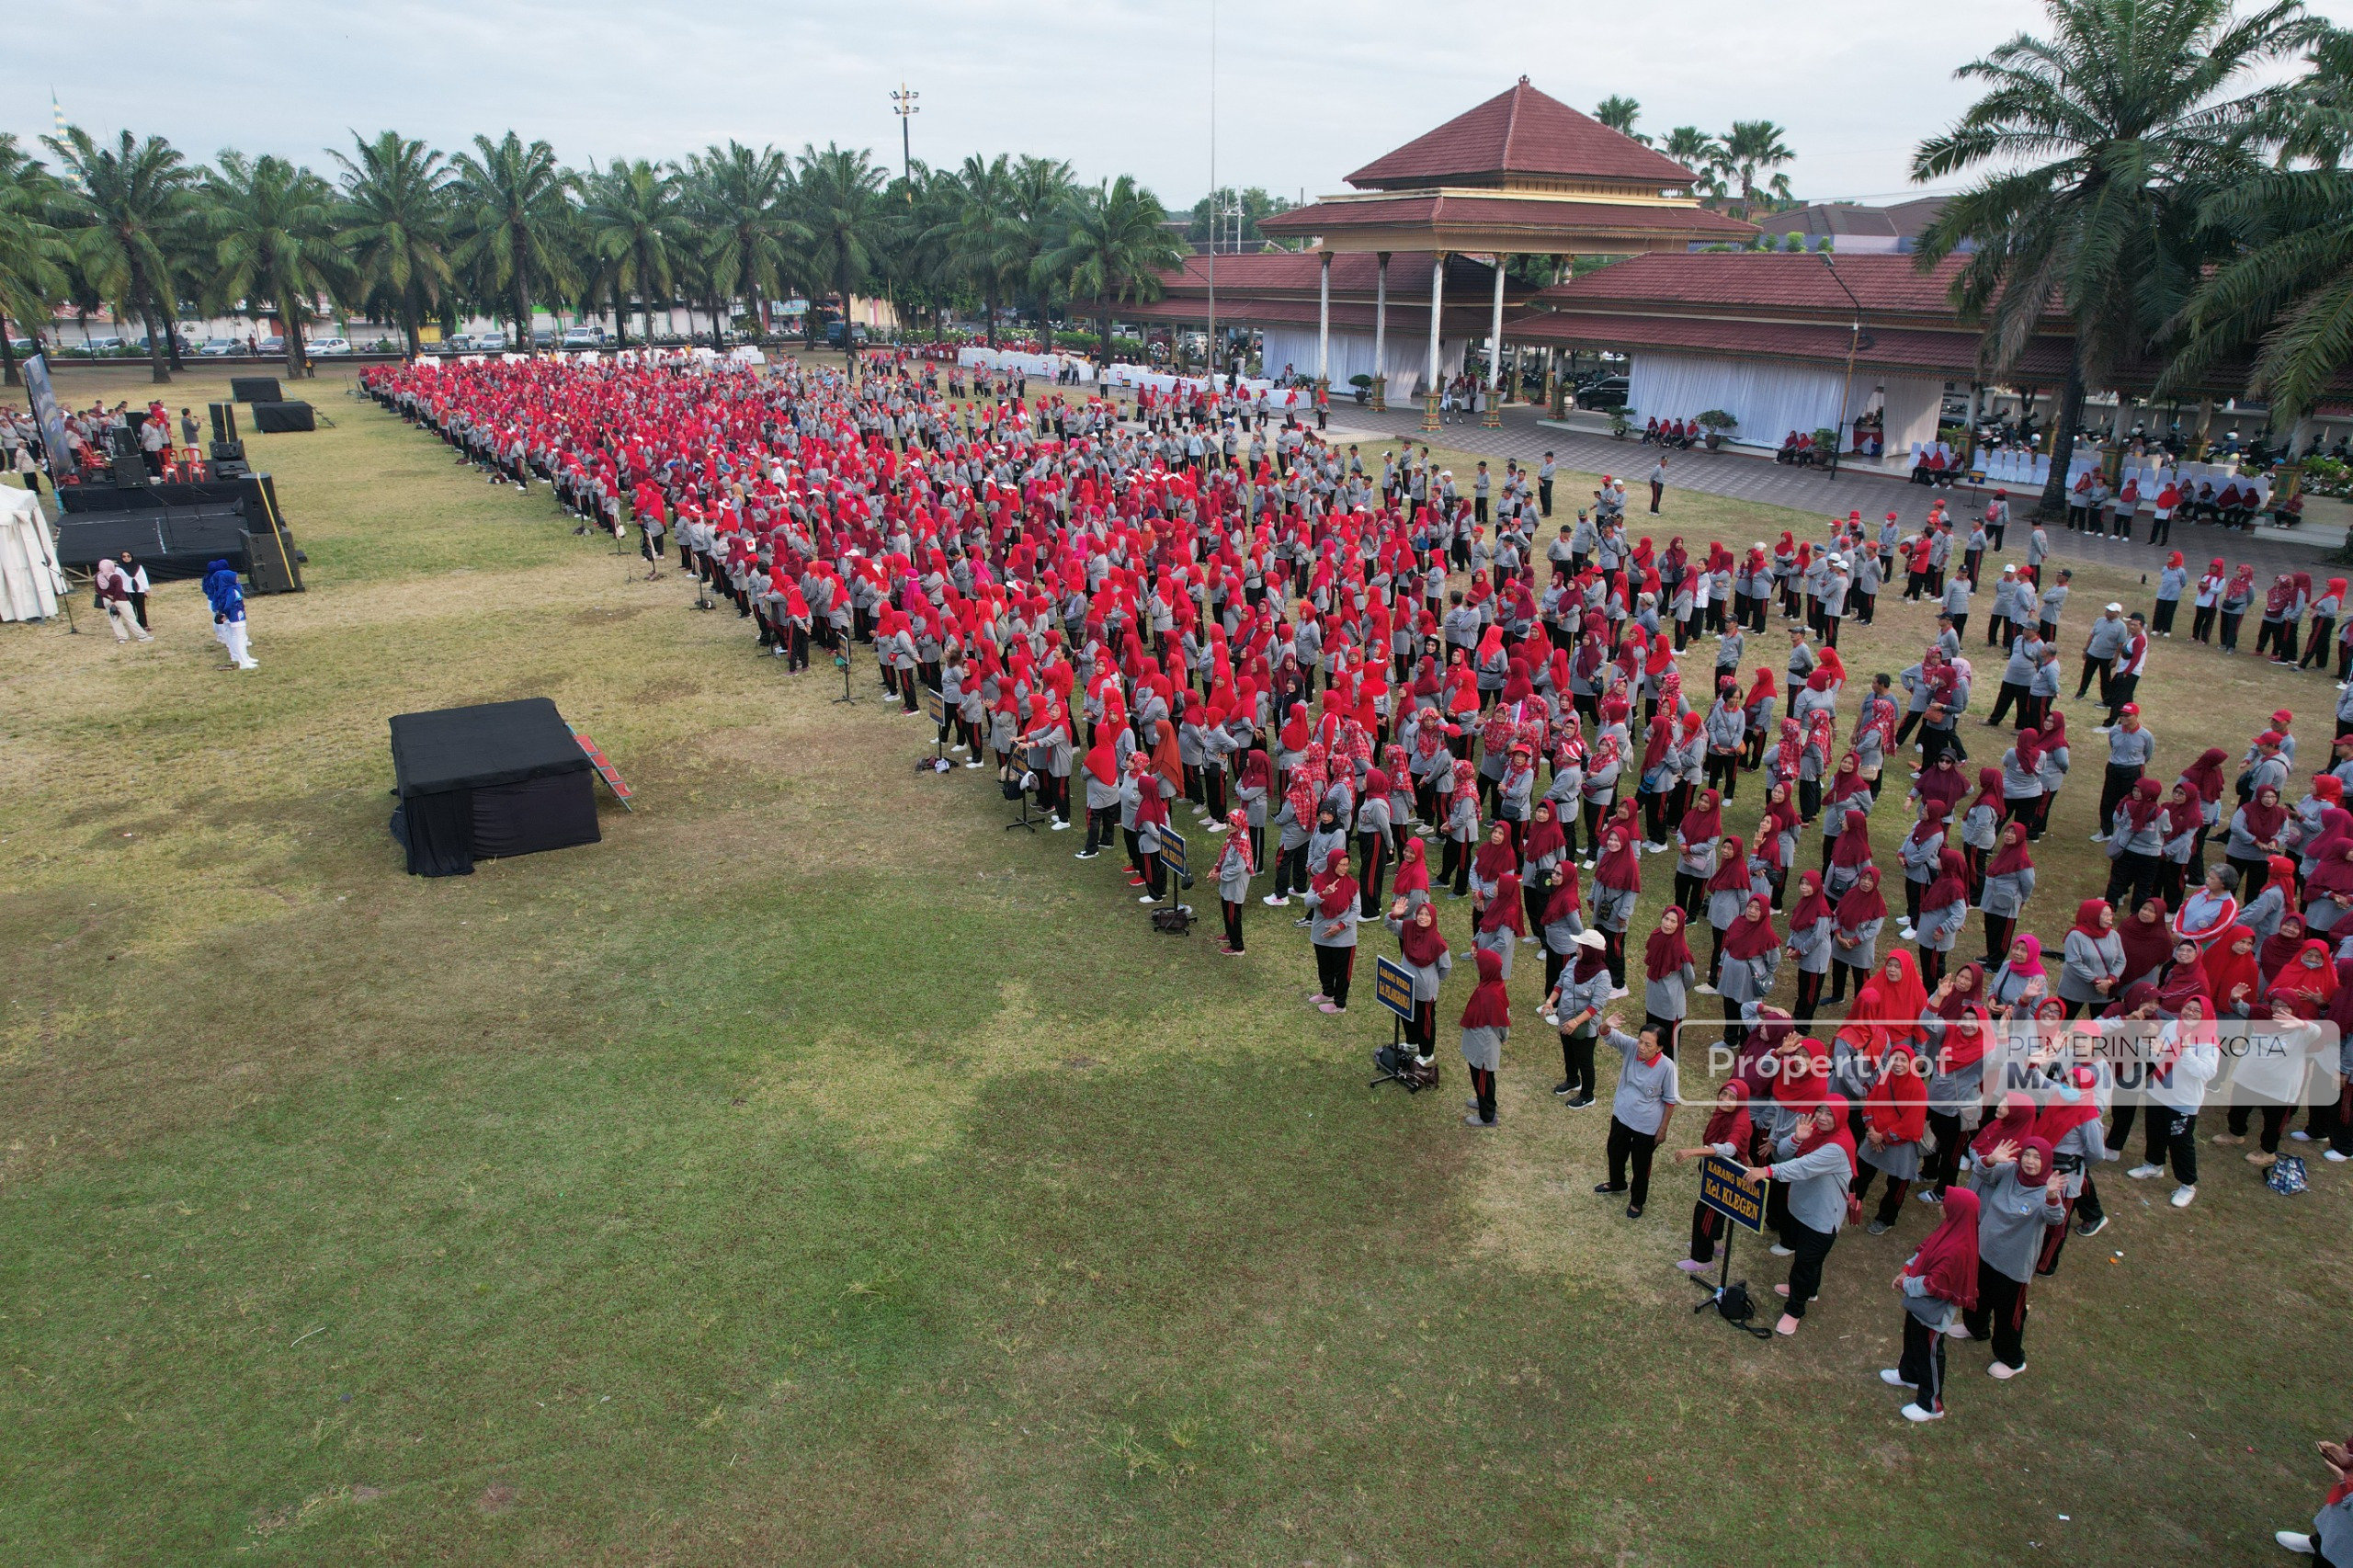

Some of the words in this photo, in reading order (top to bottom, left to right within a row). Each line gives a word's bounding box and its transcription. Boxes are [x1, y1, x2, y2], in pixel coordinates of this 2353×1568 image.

[1380, 967, 1395, 983] KARANG
[1707, 1161, 1735, 1185] KARANG
[1705, 1177, 1722, 1201] Kel.
[1722, 1187, 1760, 1221] KLEGEN
